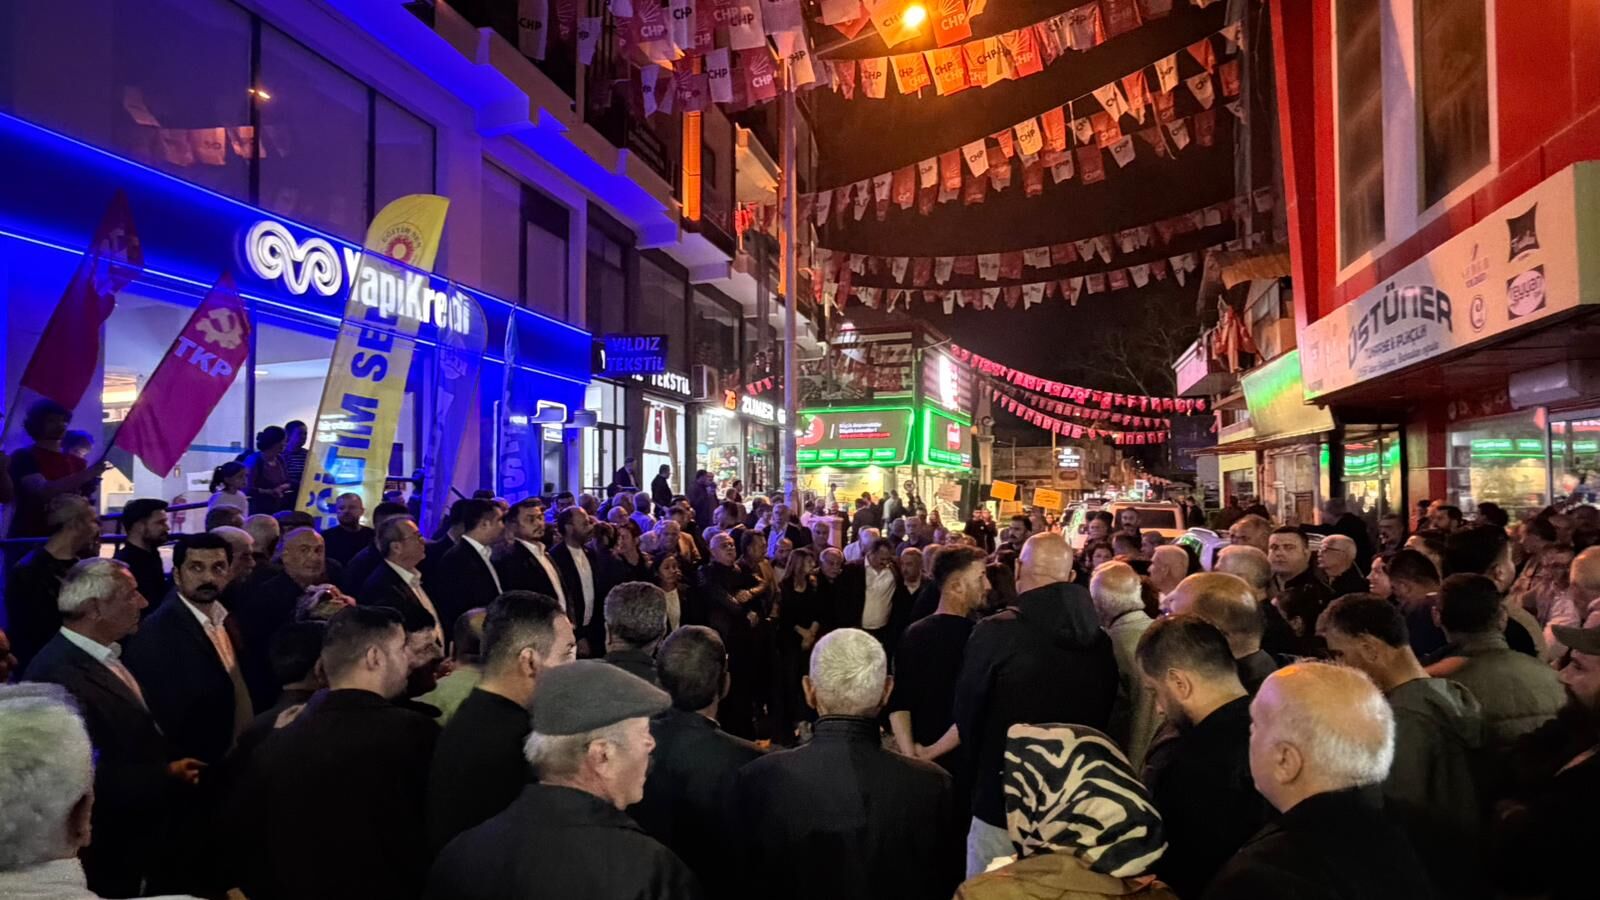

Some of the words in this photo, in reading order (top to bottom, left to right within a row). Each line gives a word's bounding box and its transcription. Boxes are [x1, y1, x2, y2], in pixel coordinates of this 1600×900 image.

[673, 7, 692, 20] CHP
[518, 18, 542, 30] CHP
[941, 13, 965, 30] CHP
[640, 25, 664, 37] CHP
[977, 51, 997, 65] CHP
[708, 68, 728, 79] CHP
[863, 71, 881, 80] CHP
[934, 62, 953, 75] CHP
[752, 74, 773, 88] CHP
[1020, 128, 1036, 142] CHP
[969, 150, 984, 163] CHP
[612, 336, 661, 351] YILDIZ
[171, 335, 233, 378] TKP
[606, 356, 665, 372] TEKSTİL
[651, 372, 691, 395] TEKSTİL
